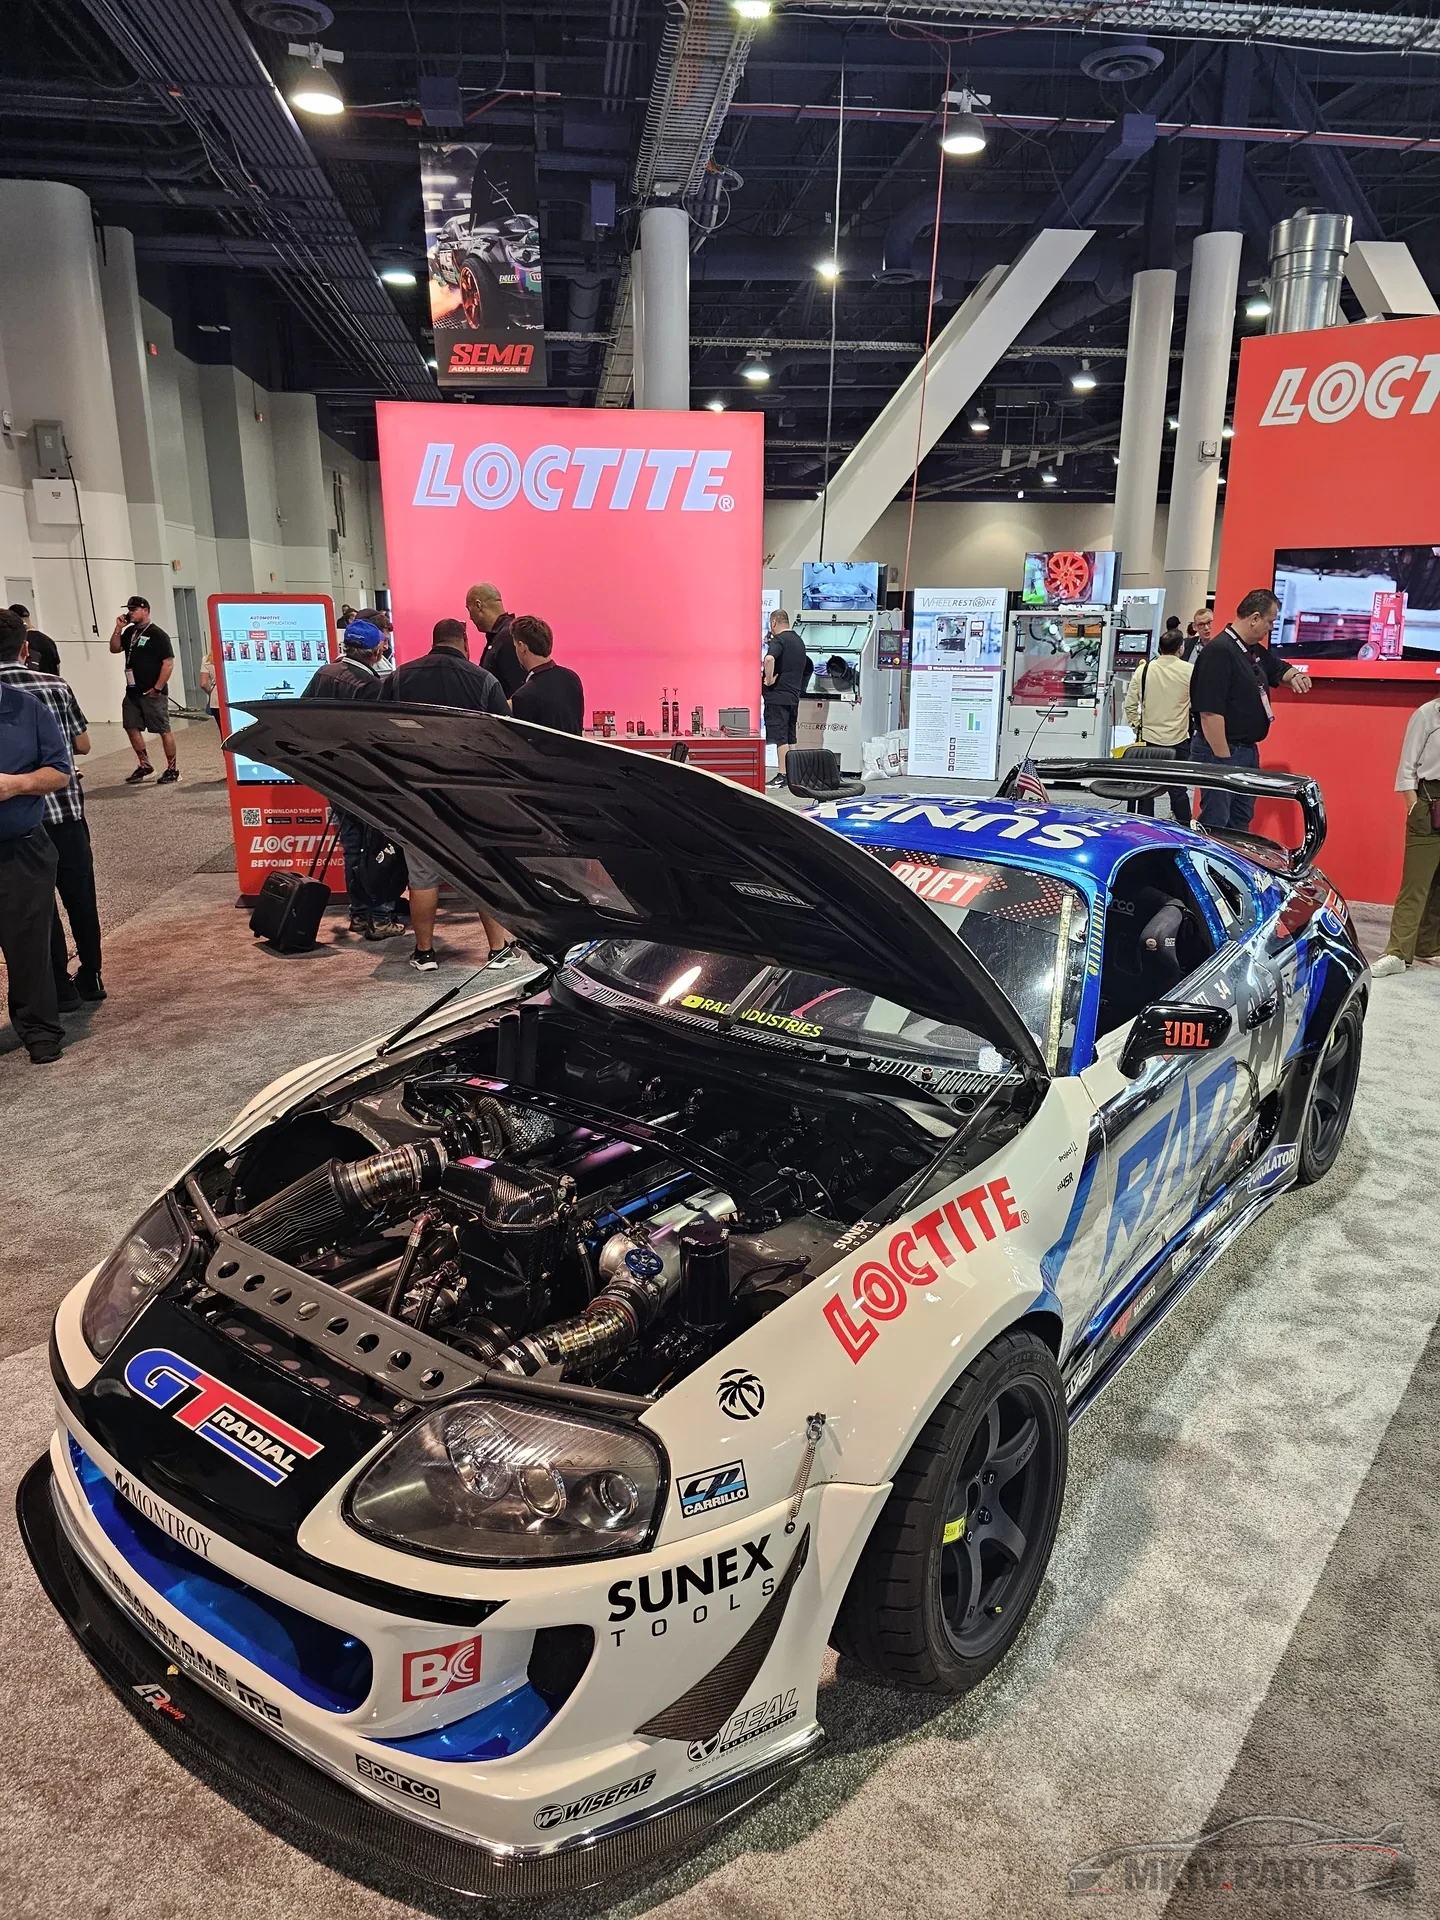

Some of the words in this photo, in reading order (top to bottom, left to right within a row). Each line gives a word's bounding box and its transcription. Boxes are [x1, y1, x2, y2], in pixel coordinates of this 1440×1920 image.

[450, 343, 535, 366] SEMA
[250, 859, 294, 868] BEYOND
[295, 858, 314, 867] THE
[1165, 1021, 1210, 1047] JBL
[833, 1219, 873, 1250] SUNEX
[845, 1222, 881, 1252] TOOLS
[124, 1347, 326, 1460] GT
[212, 1410, 298, 1473] RADIAL
[131, 1482, 213, 1559] MONTROY
[683, 1488, 747, 1516] CARRILLO
[607, 1533, 774, 1623] SUNEX
[103, 1560, 229, 1683] TREADSTONE
[610, 1577, 775, 1647] TOOLS
[410, 1642, 475, 1697] BC
[722, 1687, 799, 1745] FEAL
[723, 1712, 795, 1752] Suspension
[357, 1757, 440, 1803] sparco
[564, 1771, 656, 1821] WISEFAB
